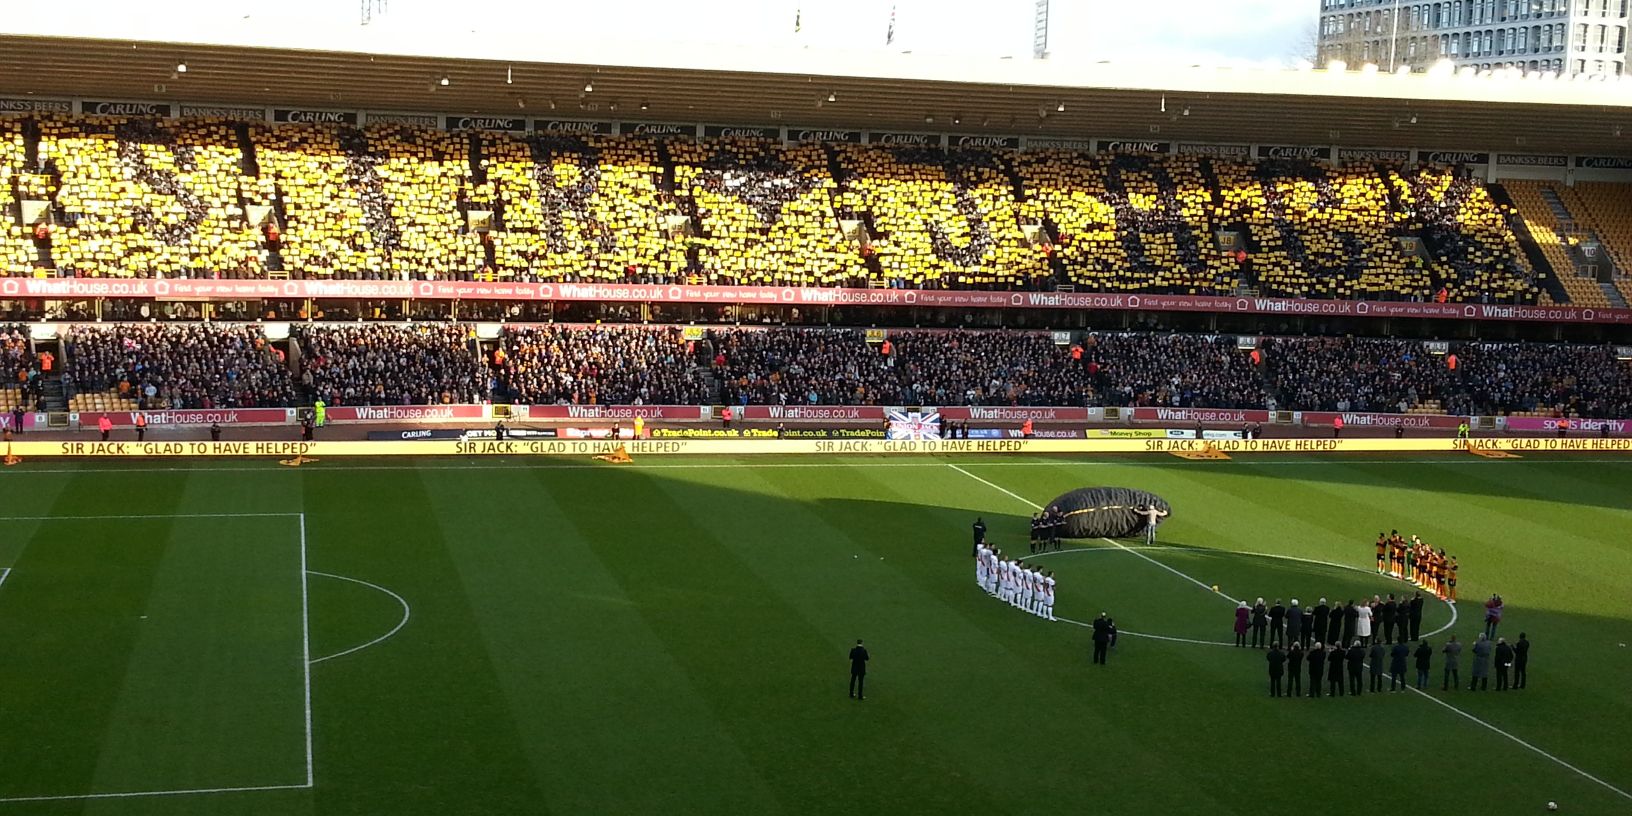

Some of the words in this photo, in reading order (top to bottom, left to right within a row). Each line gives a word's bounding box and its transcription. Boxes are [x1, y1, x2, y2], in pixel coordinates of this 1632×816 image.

[95, 102, 156, 115] CARLING
[287, 110, 344, 123] CARLING
[458, 117, 513, 131] CARLING
[547, 120, 599, 133] CARLING
[635, 122, 682, 135] CARLING
[720, 127, 764, 138] CARLING
[798, 130, 850, 142] CARLING
[881, 133, 928, 146] CARLING
[957, 135, 1008, 148] CARLING
[1108, 140, 1159, 153] CARLING
[1268, 145, 1319, 158] CARLING
[1428, 151, 1478, 163] CARLING
[26, 281, 149, 295] WhatHouse.co.uk
[304, 282, 414, 296] WhatHouse.co.uk
[559, 286, 663, 300] WhatHouse.co.uk
[801, 290, 899, 304] WhatHouse.co.uk
[1028, 292, 1123, 308] WhatHouse.co.uk
[1254, 299, 1351, 314] WhatHouse.co.uk
[1482, 305, 1577, 320] WhatHouse.co.uk
[355, 406, 454, 420] WhatHouse.co.uk
[567, 405, 664, 418] WhatHouse.co.uk
[969, 407, 1056, 420] WhatHouse.co.uk
[1157, 408, 1246, 422] WhatHouse.co.uk
[1342, 412, 1431, 427] WhatHouse.co.uk
[1543, 419, 1578, 431] spts
[1580, 418, 1625, 432] idenity
[401, 429, 433, 439] CARLING
[660, 428, 740, 438] TradePoint.co.uk
[750, 428, 828, 438] Tradeoint.co.uk
[839, 428, 886, 438] TradePoin
[1008, 429, 1078, 438] WhHouse.co.uk
[1110, 430, 1135, 438] Money
[1135, 430, 1153, 438] Shop
[61, 442, 84, 454] SIR
[90, 442, 129, 454] JACK:
[189, 442, 207, 454] TO
[212, 442, 249, 454] HAVE
[456, 441, 476, 453] SIR
[482, 441, 518, 453] JACK:
[571, 441, 588, 453] TO
[815, 440, 834, 451] SIR
[839, 440, 872, 451] JACK:
[922, 440, 937, 451] TO
[941, 440, 972, 451] HAVE
[1145, 439, 1163, 451] SIR
[1167, 439, 1199, 451] JACK:
[1244, 439, 1258, 451] TO
[1262, 439, 1291, 451] HAVE
[1474, 438, 1503, 449] JACK:
[1545, 438, 1558, 449] TO
[1561, 438, 1588, 449] HAVE
[1592, 438, 1632, 449] HELPED
